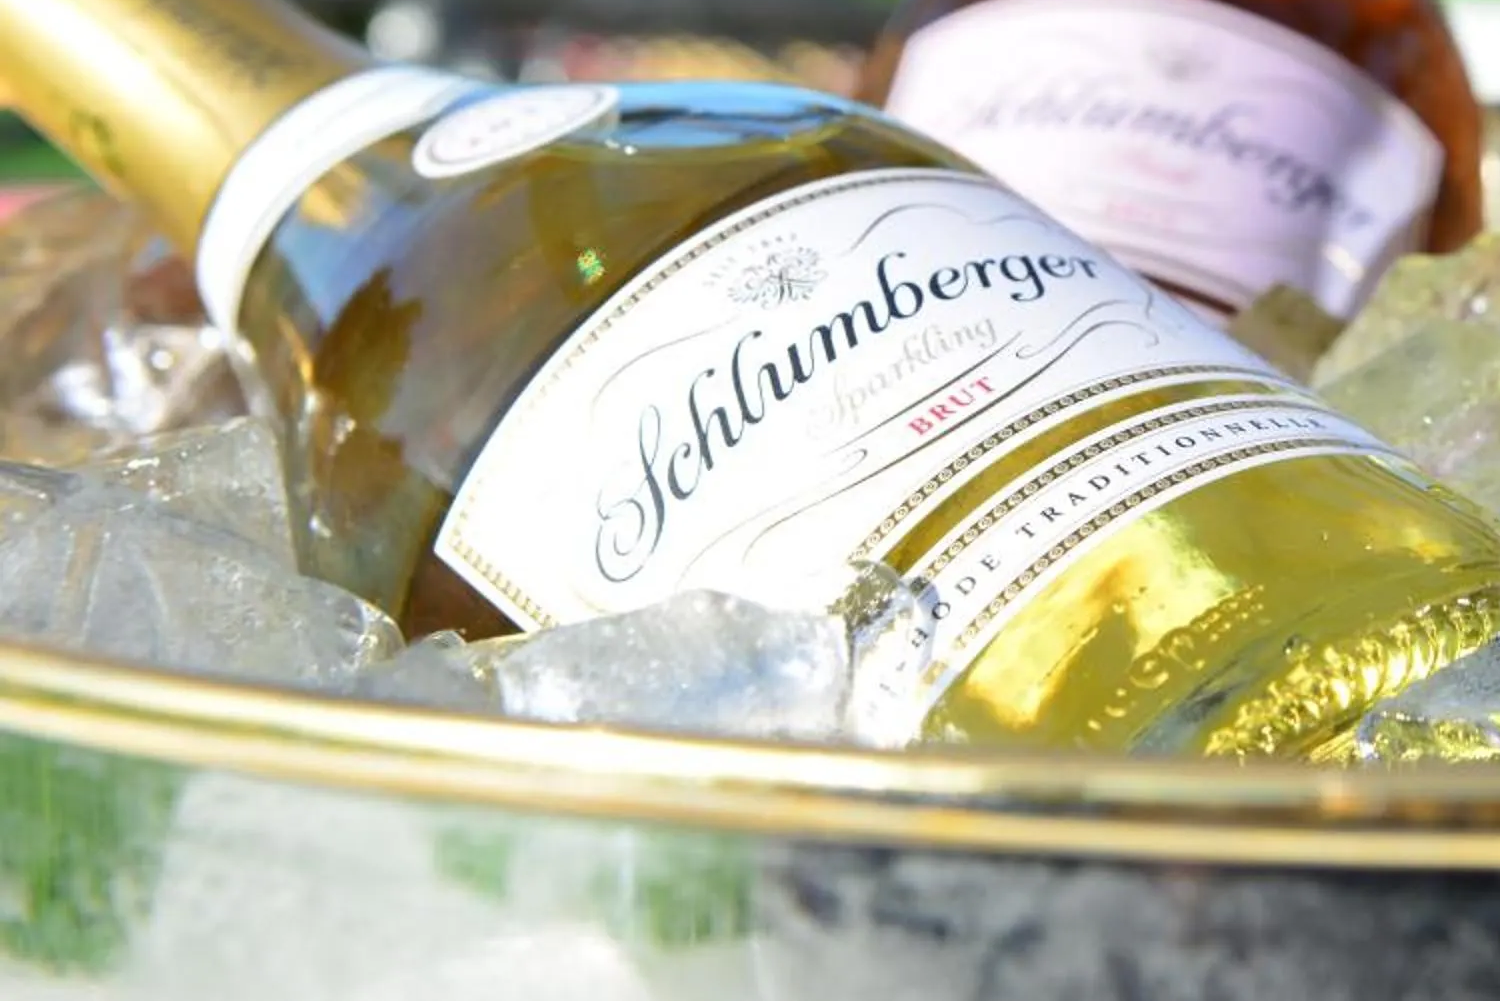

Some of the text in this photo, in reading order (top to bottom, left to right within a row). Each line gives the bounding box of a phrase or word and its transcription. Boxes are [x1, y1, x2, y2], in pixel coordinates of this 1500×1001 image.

[595, 252, 1100, 583] Schlumberger
[806, 318, 998, 440] Sparkling
[908, 376, 996, 435] BRUT
[1015, 415, 1325, 541] TRADITIONNELLE
